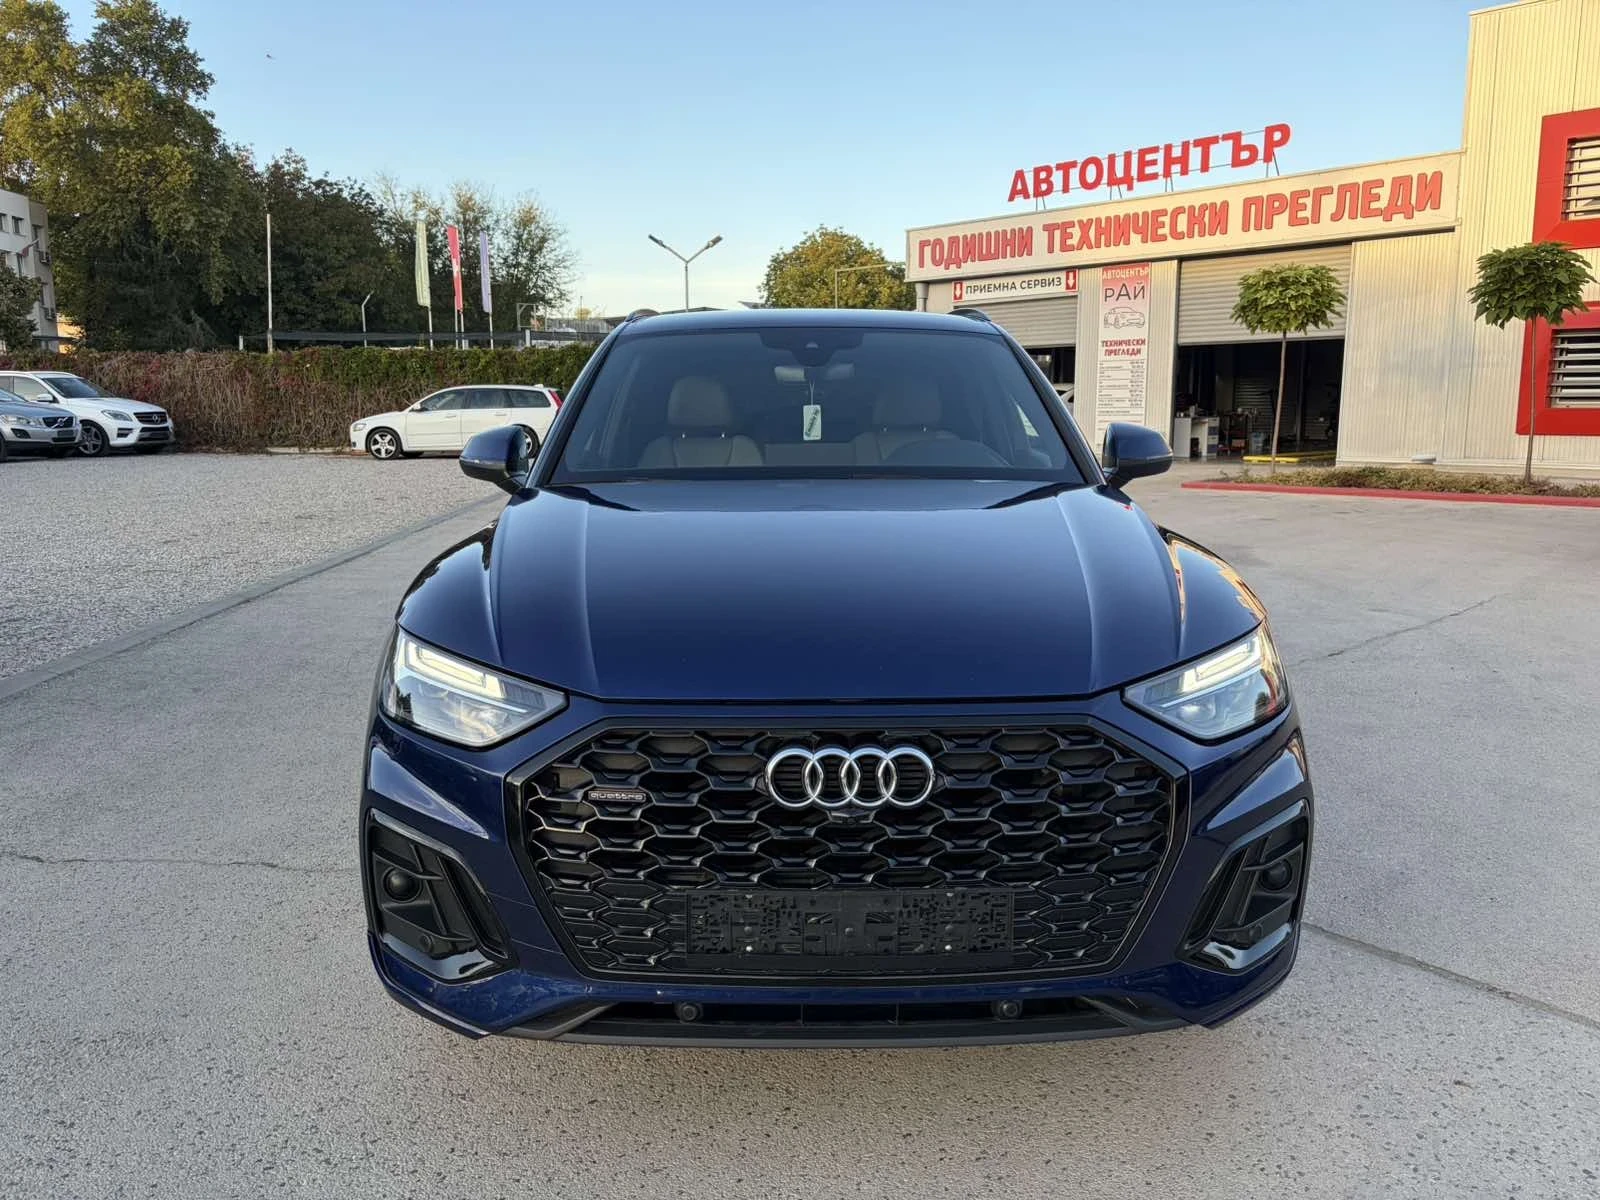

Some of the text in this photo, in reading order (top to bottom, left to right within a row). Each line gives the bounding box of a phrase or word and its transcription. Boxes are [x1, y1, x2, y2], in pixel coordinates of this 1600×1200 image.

[1008, 123, 1292, 202] АВТОЦЕНТЪР
[918, 170, 1443, 271] ГОДИШНИ ТЕХНИЧЕСКИ ПРЕГЛЕДИ
[1102, 267, 1149, 280] АВТОЦЕНТЪР
[965, 276, 1062, 294] ПРИЕМНА СЕРВИЗ
[1101, 338, 1146, 348] ТЕХНИЧЕСКИ
[1104, 348, 1142, 357] ПРЕГЛЕДИ
[590, 792, 643, 801] quattro
